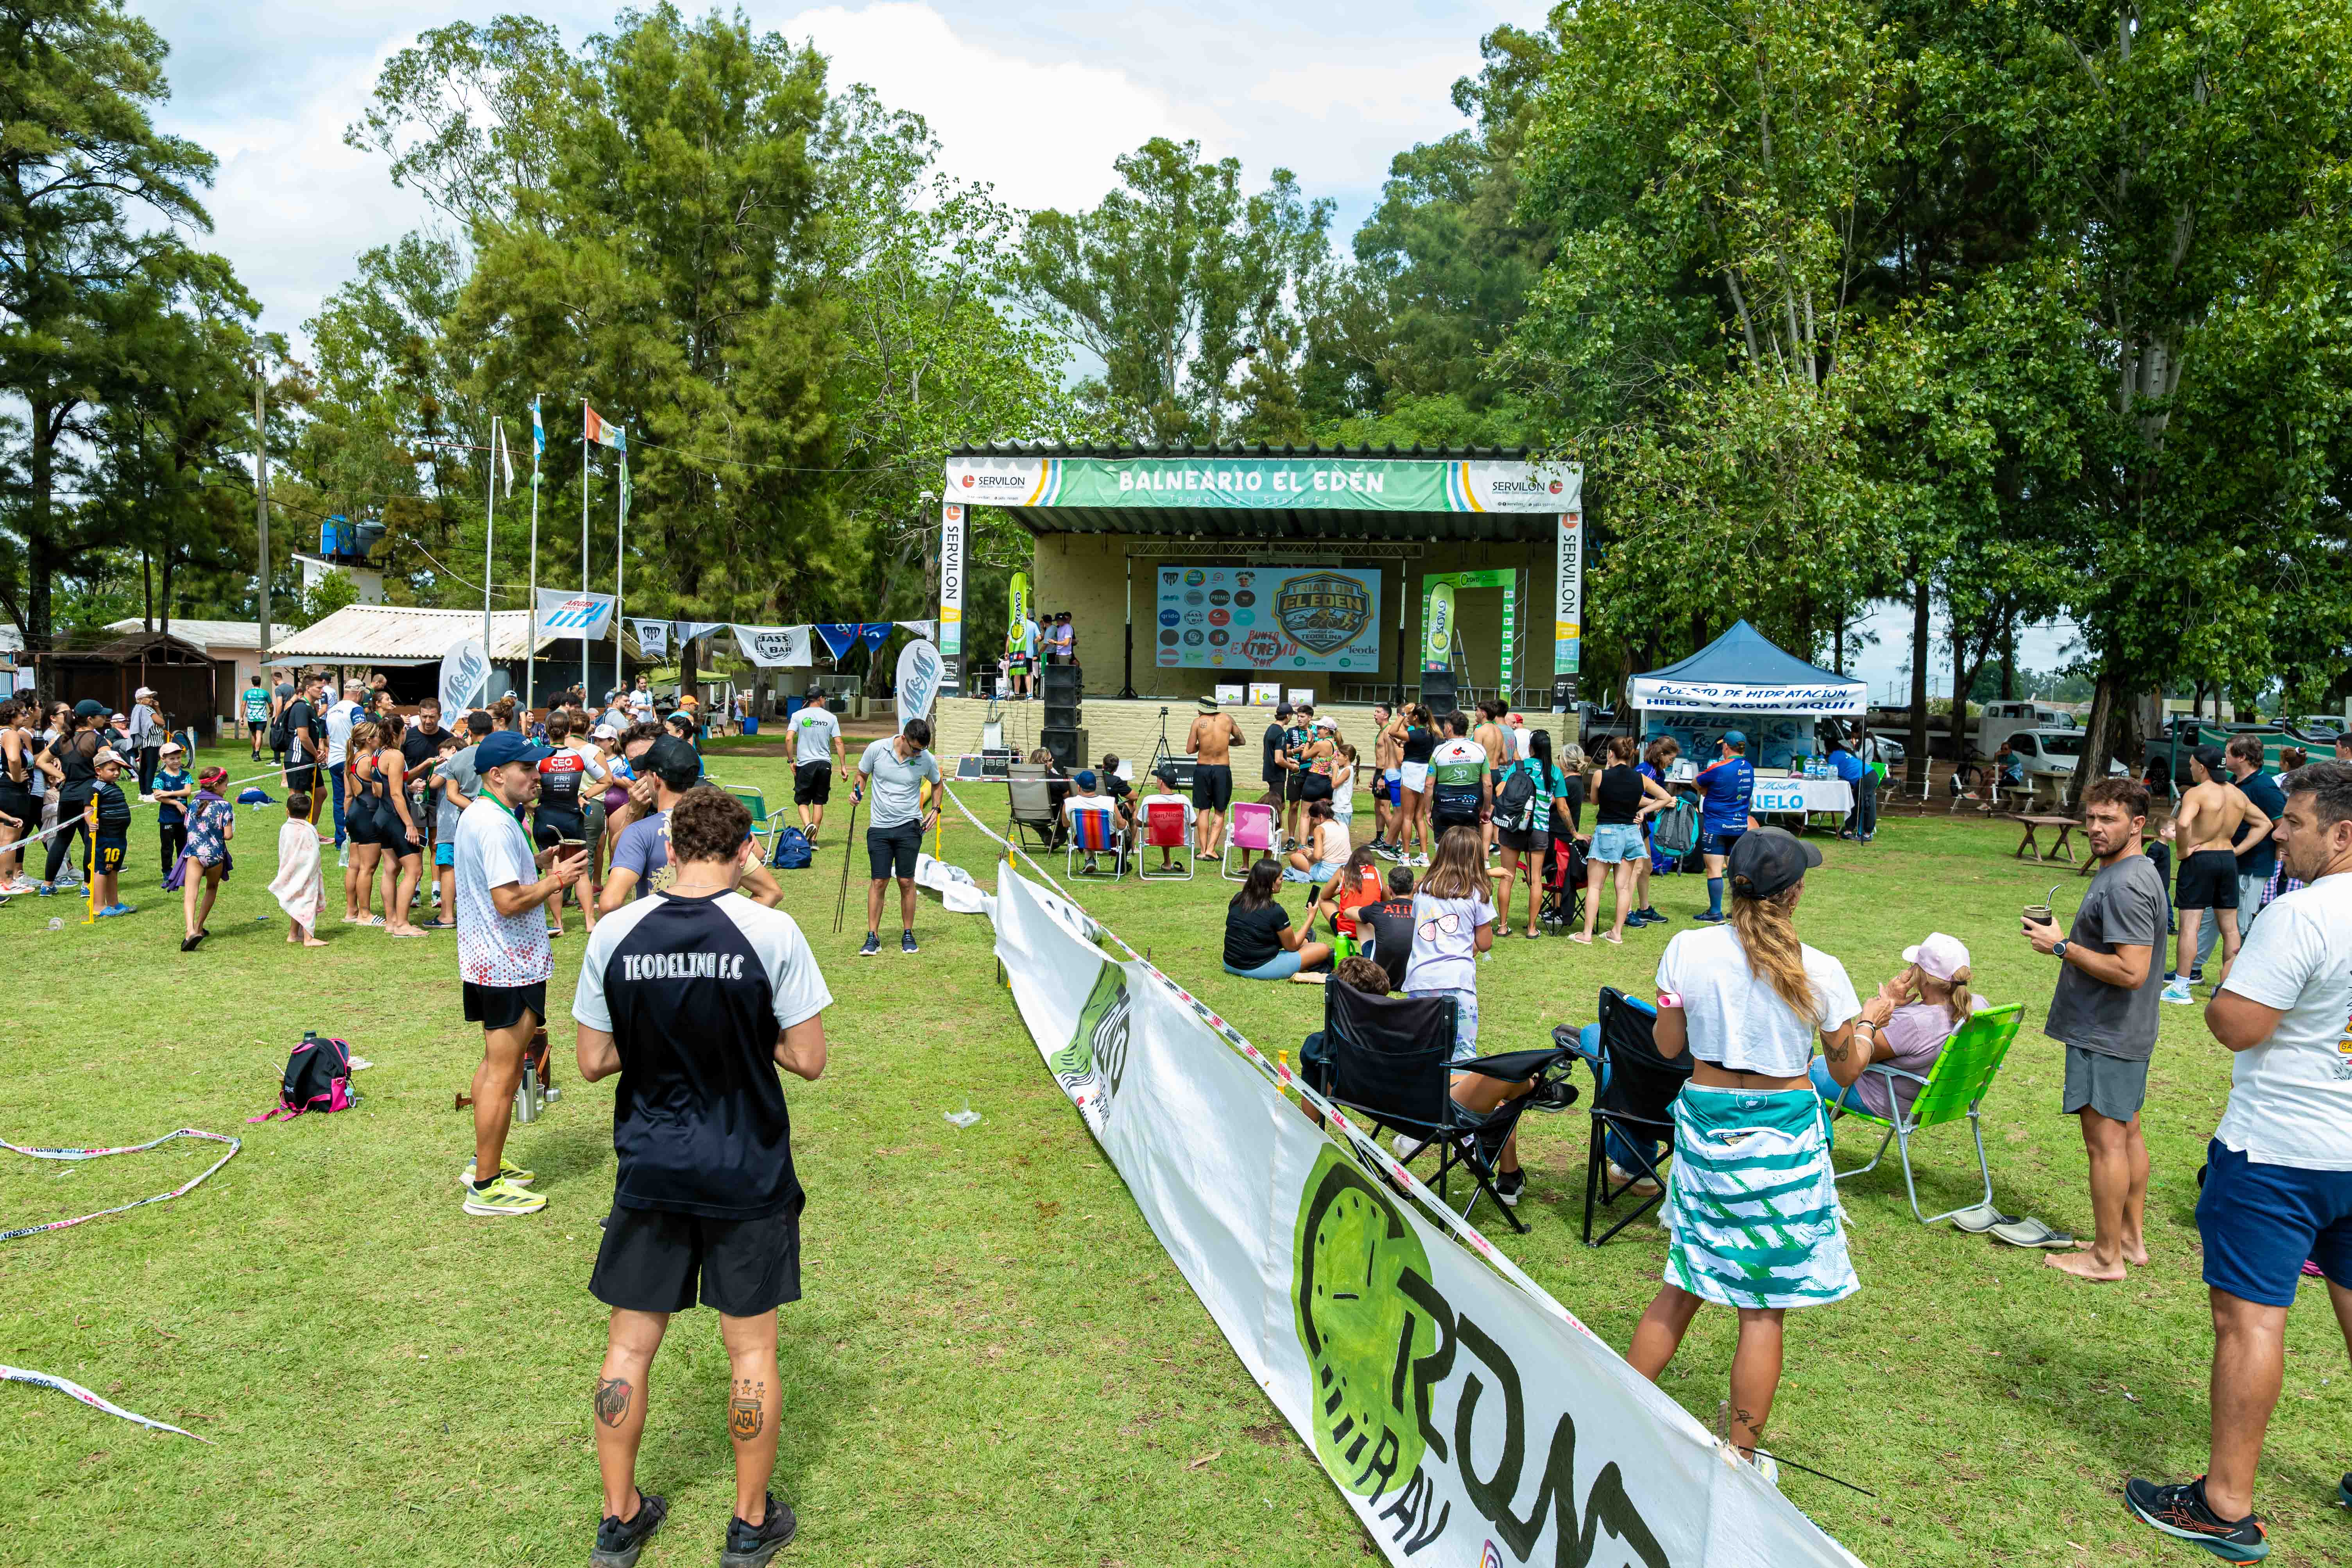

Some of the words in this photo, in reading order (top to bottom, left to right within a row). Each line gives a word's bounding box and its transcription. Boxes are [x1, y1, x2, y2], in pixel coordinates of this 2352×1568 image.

[979, 477, 1025, 486] SERVILON
[1119, 470, 1262, 491] BALNEARIO
[1273, 471, 1302, 492] EL
[1313, 467, 1384, 493] EDÉN
[1492, 482, 1545, 491] SERVILON
[1263, 496, 1305, 505] Santa
[1315, 496, 1329, 505] Fe
[946, 526, 958, 600] SERVILON
[1561, 534, 1576, 614] SERVILON
[1291, 584, 1354, 595] TRIATLON
[1283, 595, 1307, 610] EL
[1310, 594, 1363, 612] EDEN
[1248, 630, 1279, 640] PUNTO
[1230, 642, 1299, 656] EXTREMO
[1252, 658, 1272, 668] SUR
[1254, 688, 1263, 705] 1
[1664, 715, 1733, 728] HIELO
[551, 758, 573, 767] CEO
[104, 848, 120, 862] 10
[623, 953, 716, 980] TEODELINA
[719, 953, 745, 980] F.C
[735, 1410, 755, 1429] AFA
